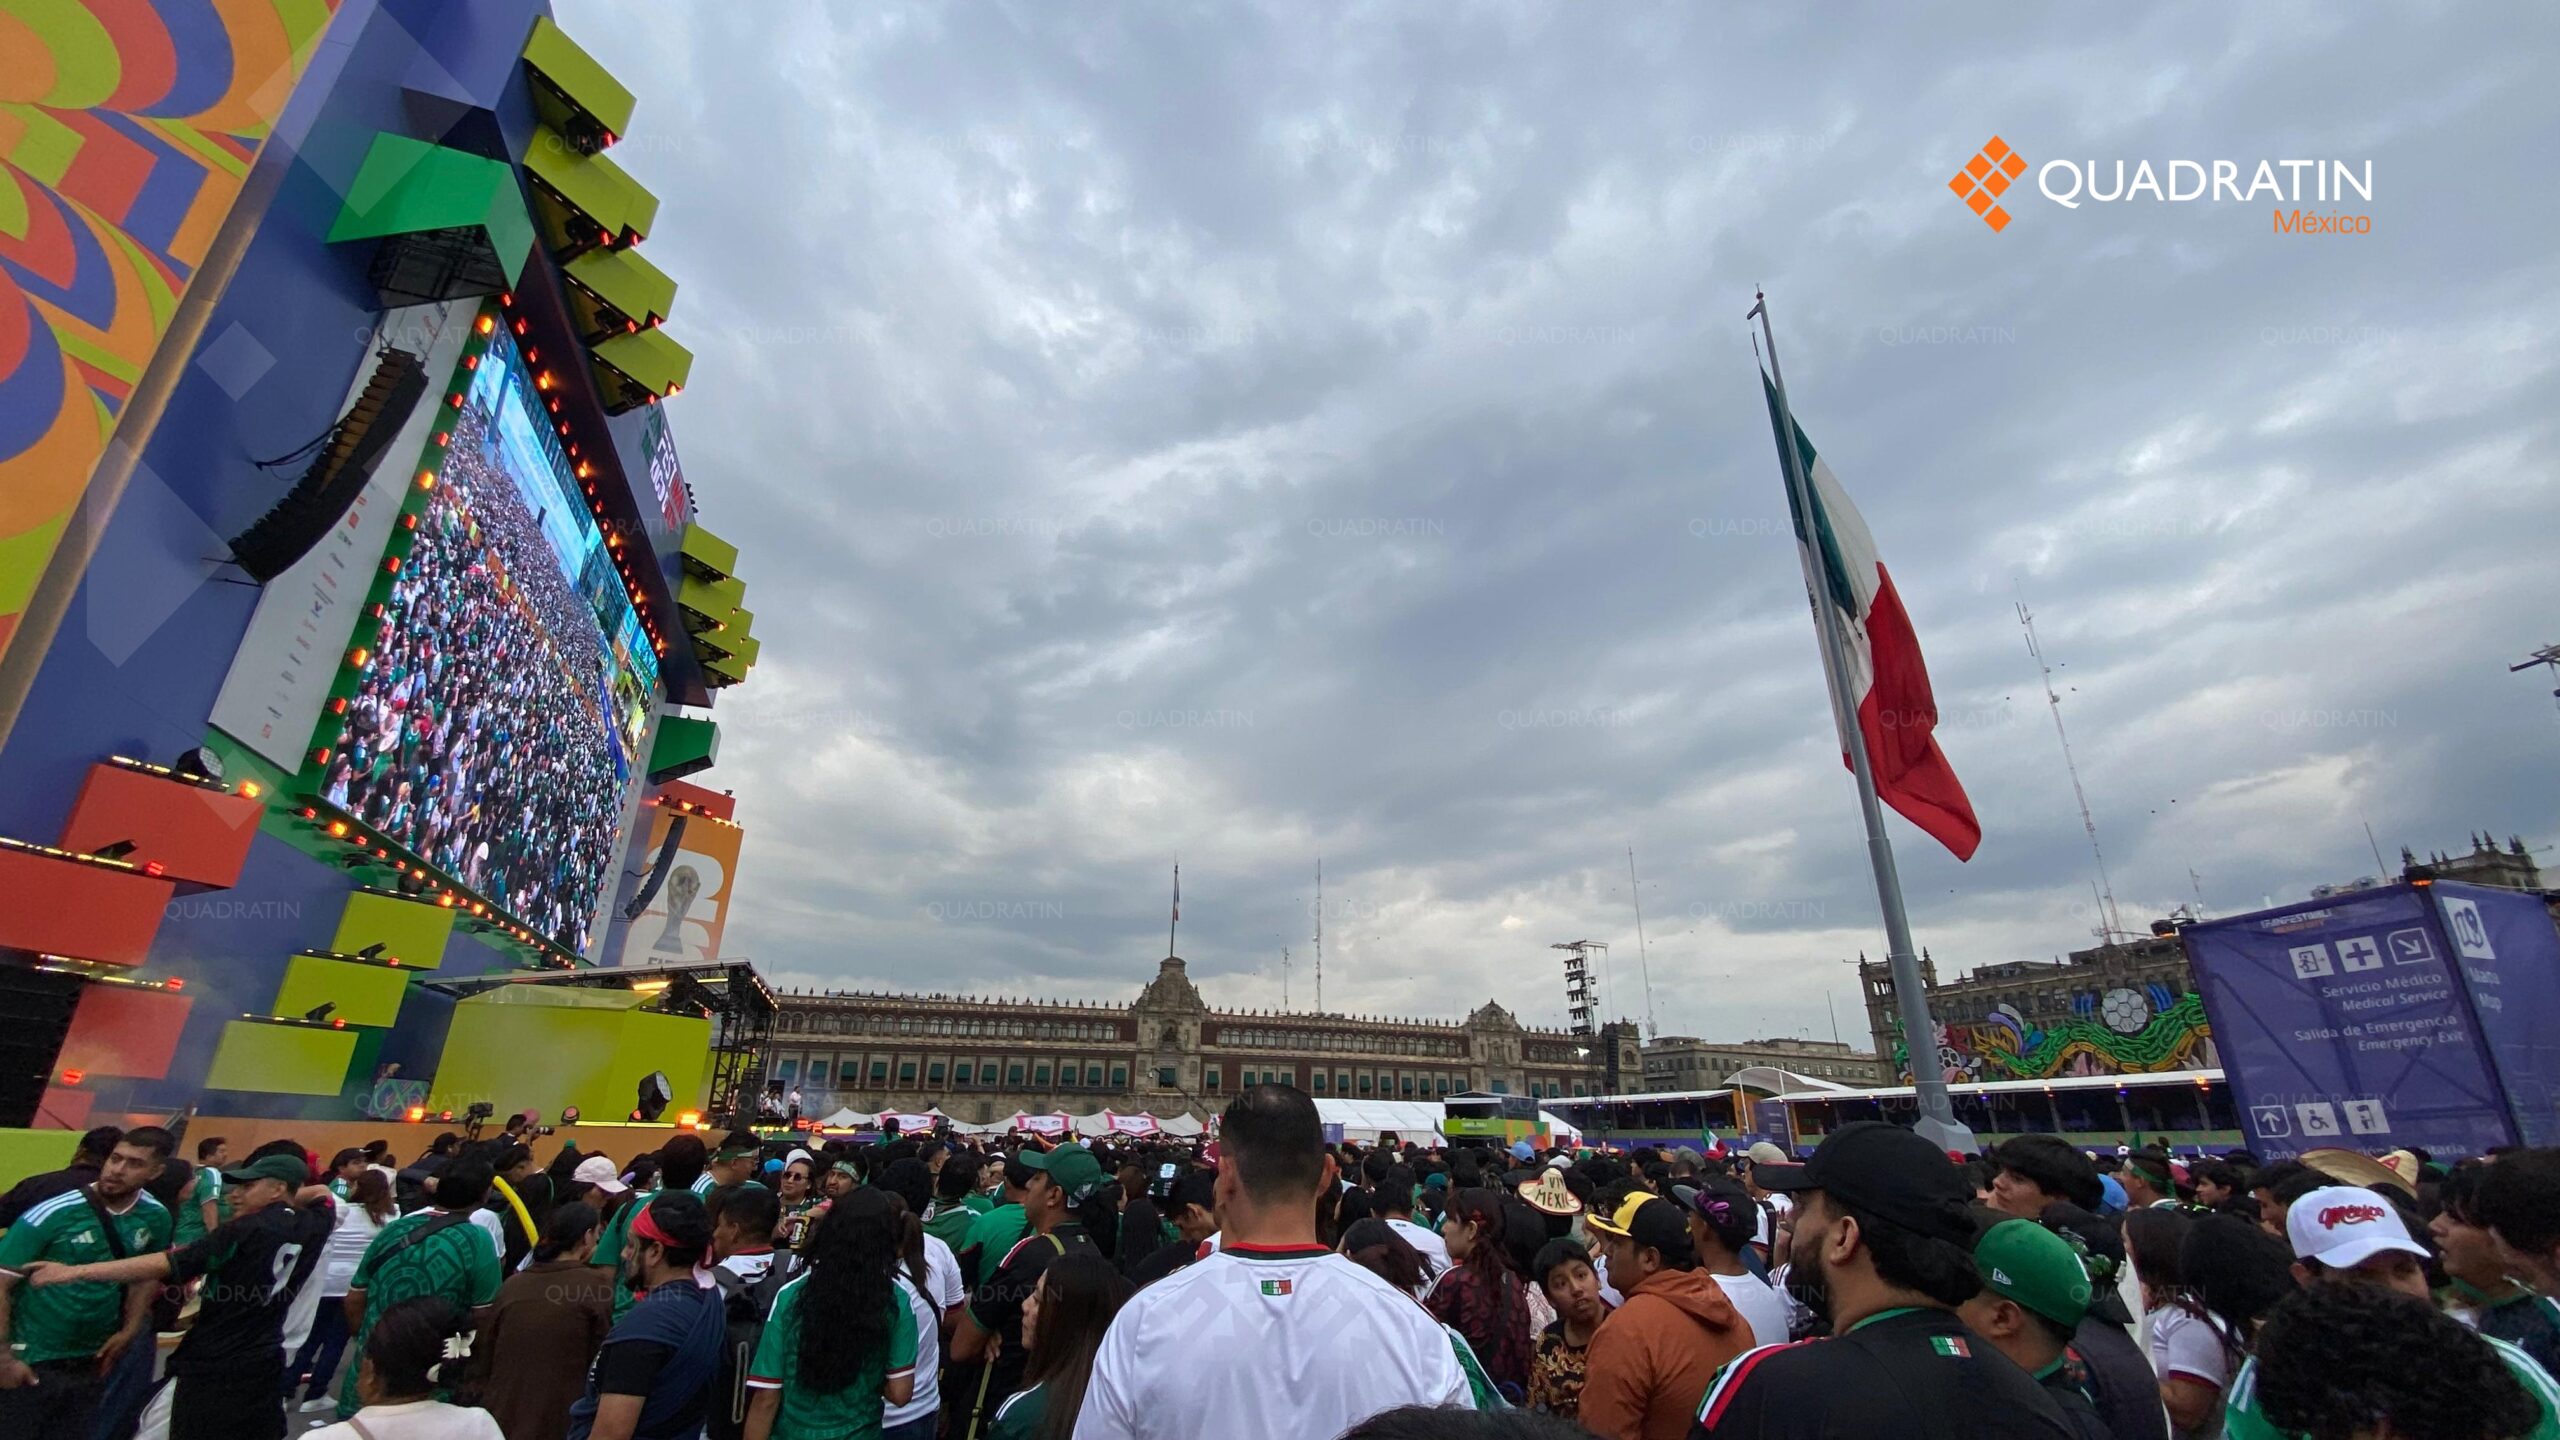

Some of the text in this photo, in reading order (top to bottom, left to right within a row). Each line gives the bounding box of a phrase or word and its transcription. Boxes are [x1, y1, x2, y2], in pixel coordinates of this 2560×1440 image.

[2322, 973, 2442, 998] Servicio Médico
[2342, 989, 2448, 1011] Medical Service
[2295, 1015, 2457, 1042] Salida de Emergencia
[2358, 1031, 2464, 1051] Emergency Exit
[2264, 1149, 2297, 1160] Zona
[273, 1242, 303, 1305] 9
